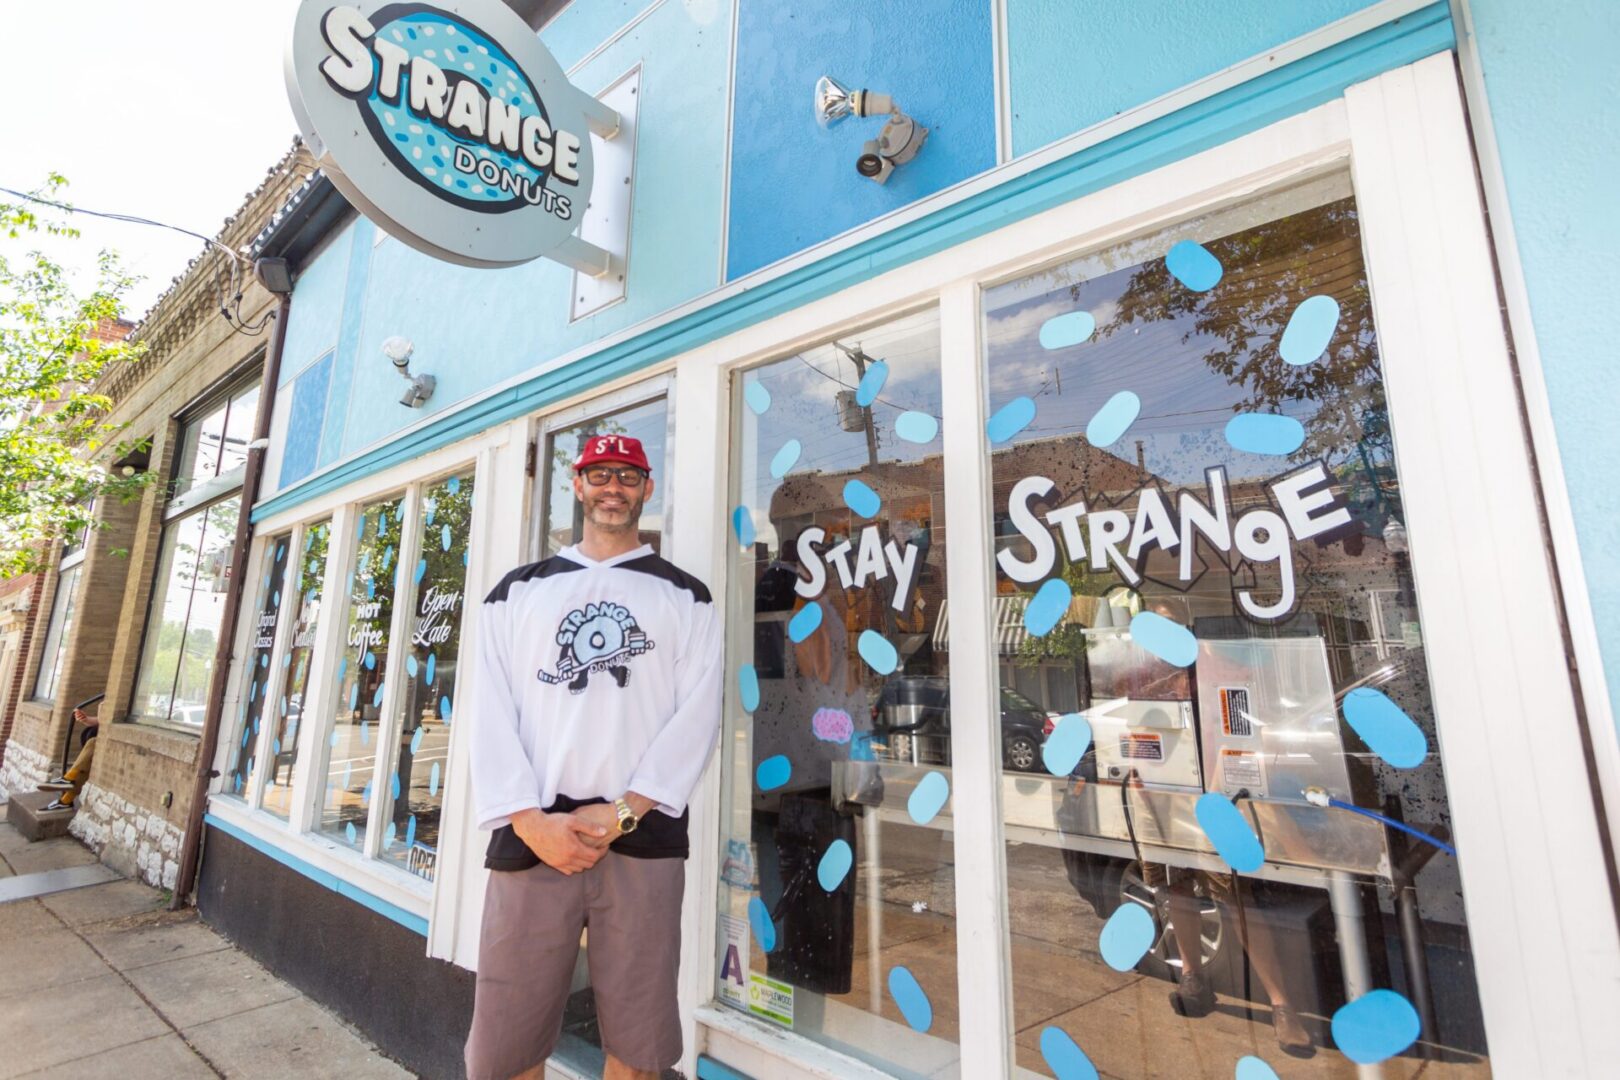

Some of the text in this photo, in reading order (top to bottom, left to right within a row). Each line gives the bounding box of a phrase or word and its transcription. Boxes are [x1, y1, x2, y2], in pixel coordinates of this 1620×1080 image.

[320, 4, 581, 185] STRANGE
[455, 145, 572, 220] DONUTS
[595, 436, 630, 455] STL
[794, 525, 919, 612] STAY
[357, 603, 381, 619] HOT
[421, 585, 459, 618] Open
[348, 622, 383, 665] Coffee
[411, 611, 452, 647] Late
[556, 601, 636, 647] STRANGE
[590, 652, 631, 674] DONUTS
[720, 943, 744, 986] A
